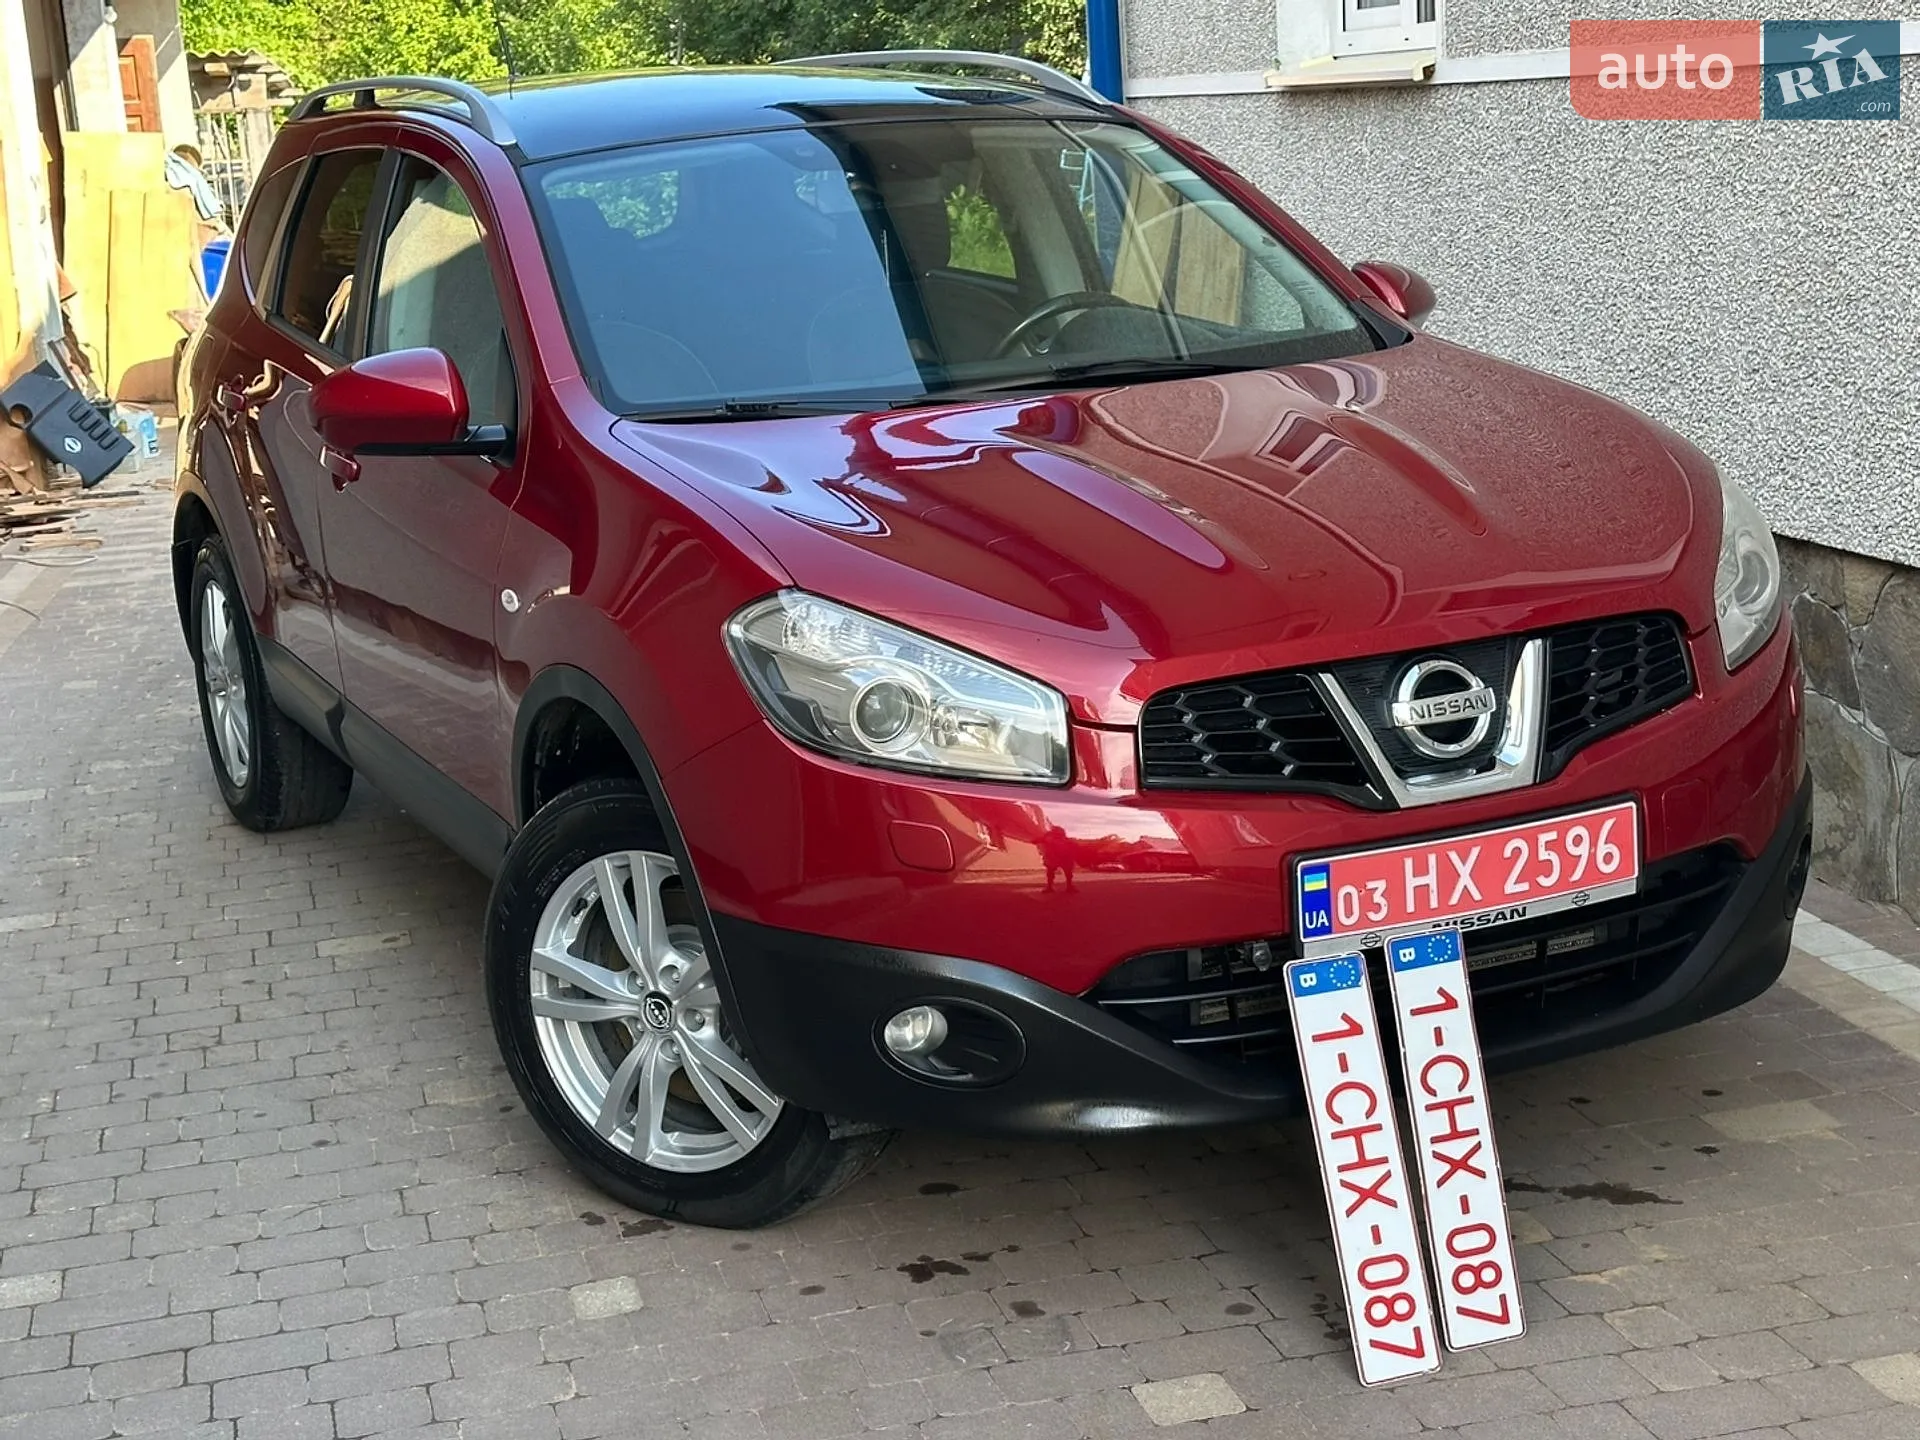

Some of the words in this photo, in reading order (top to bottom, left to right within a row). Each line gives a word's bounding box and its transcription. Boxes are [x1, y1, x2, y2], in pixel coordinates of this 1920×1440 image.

[1409, 693, 1489, 721] NISSAN
[1336, 878, 1389, 927] 03
[1404, 845, 1484, 914] HX
[1502, 817, 1622, 896] 2596
[1304, 910, 1330, 930] UA
[1432, 906, 1528, 930] SSAN
[1399, 947, 1417, 963] B
[1299, 971, 1318, 988] B
[1409, 986, 1511, 1326] 1-CHX-087
[1311, 1012, 1426, 1360] 1-CHX-087
